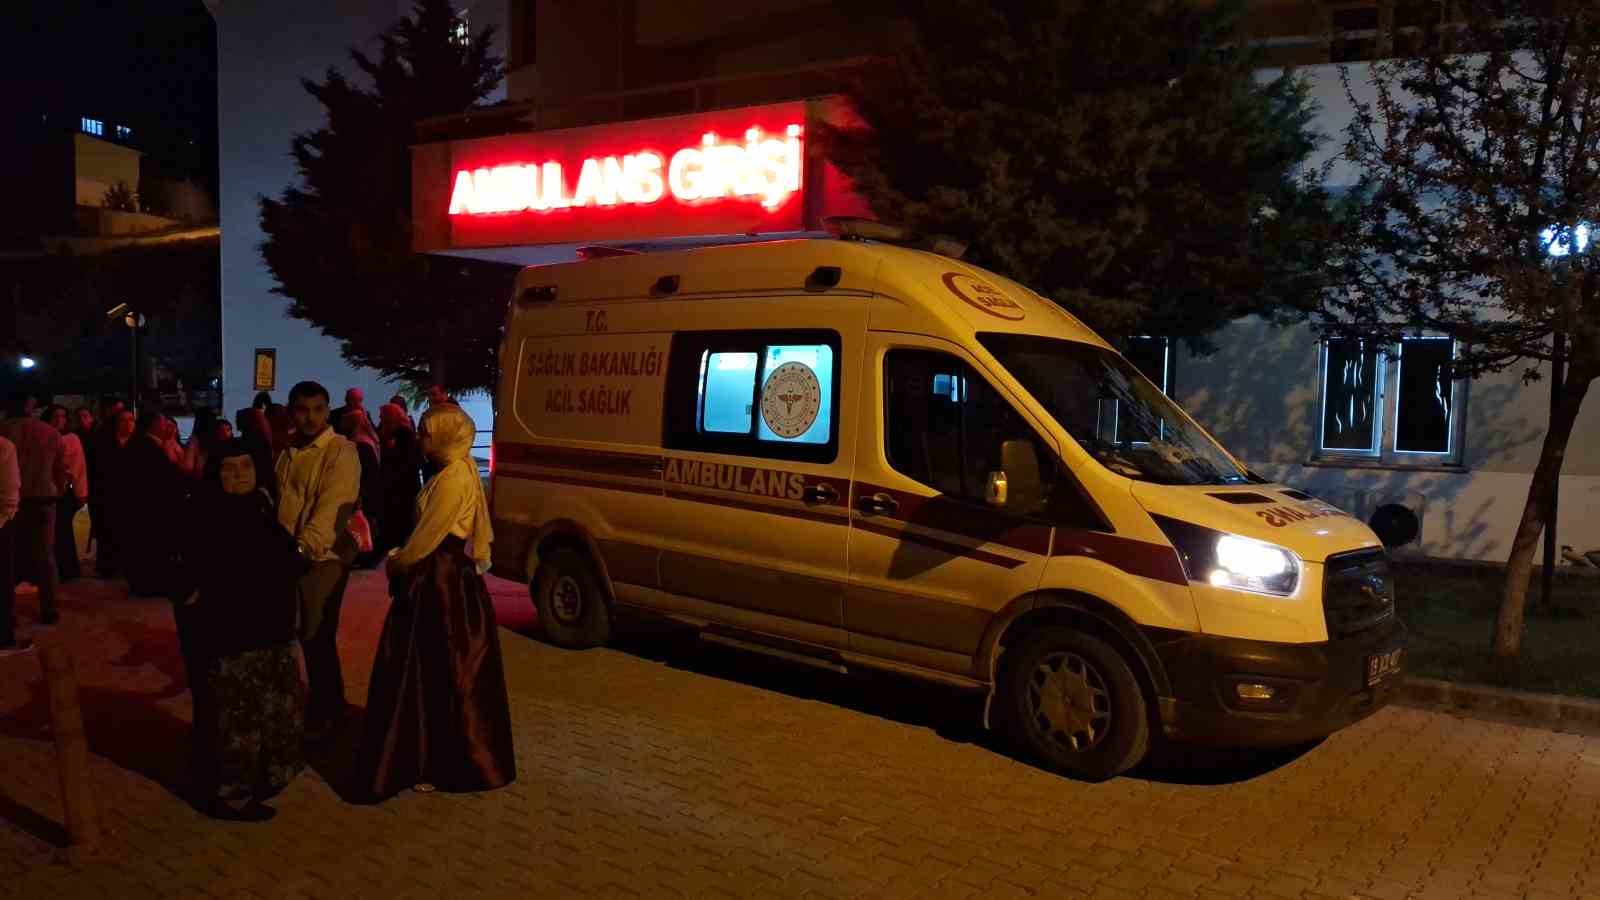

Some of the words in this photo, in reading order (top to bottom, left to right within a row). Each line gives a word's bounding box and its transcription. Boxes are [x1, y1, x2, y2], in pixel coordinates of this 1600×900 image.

[449, 152, 663, 215] AMBULANS
[585, 310, 608, 332] T.C.
[528, 348, 576, 376] SAĞLIK
[579, 346, 663, 376] BAKANLIĞI
[545, 384, 574, 413] ACİL
[577, 384, 632, 414] SAĞLIK
[664, 458, 804, 499] AMBULANS
